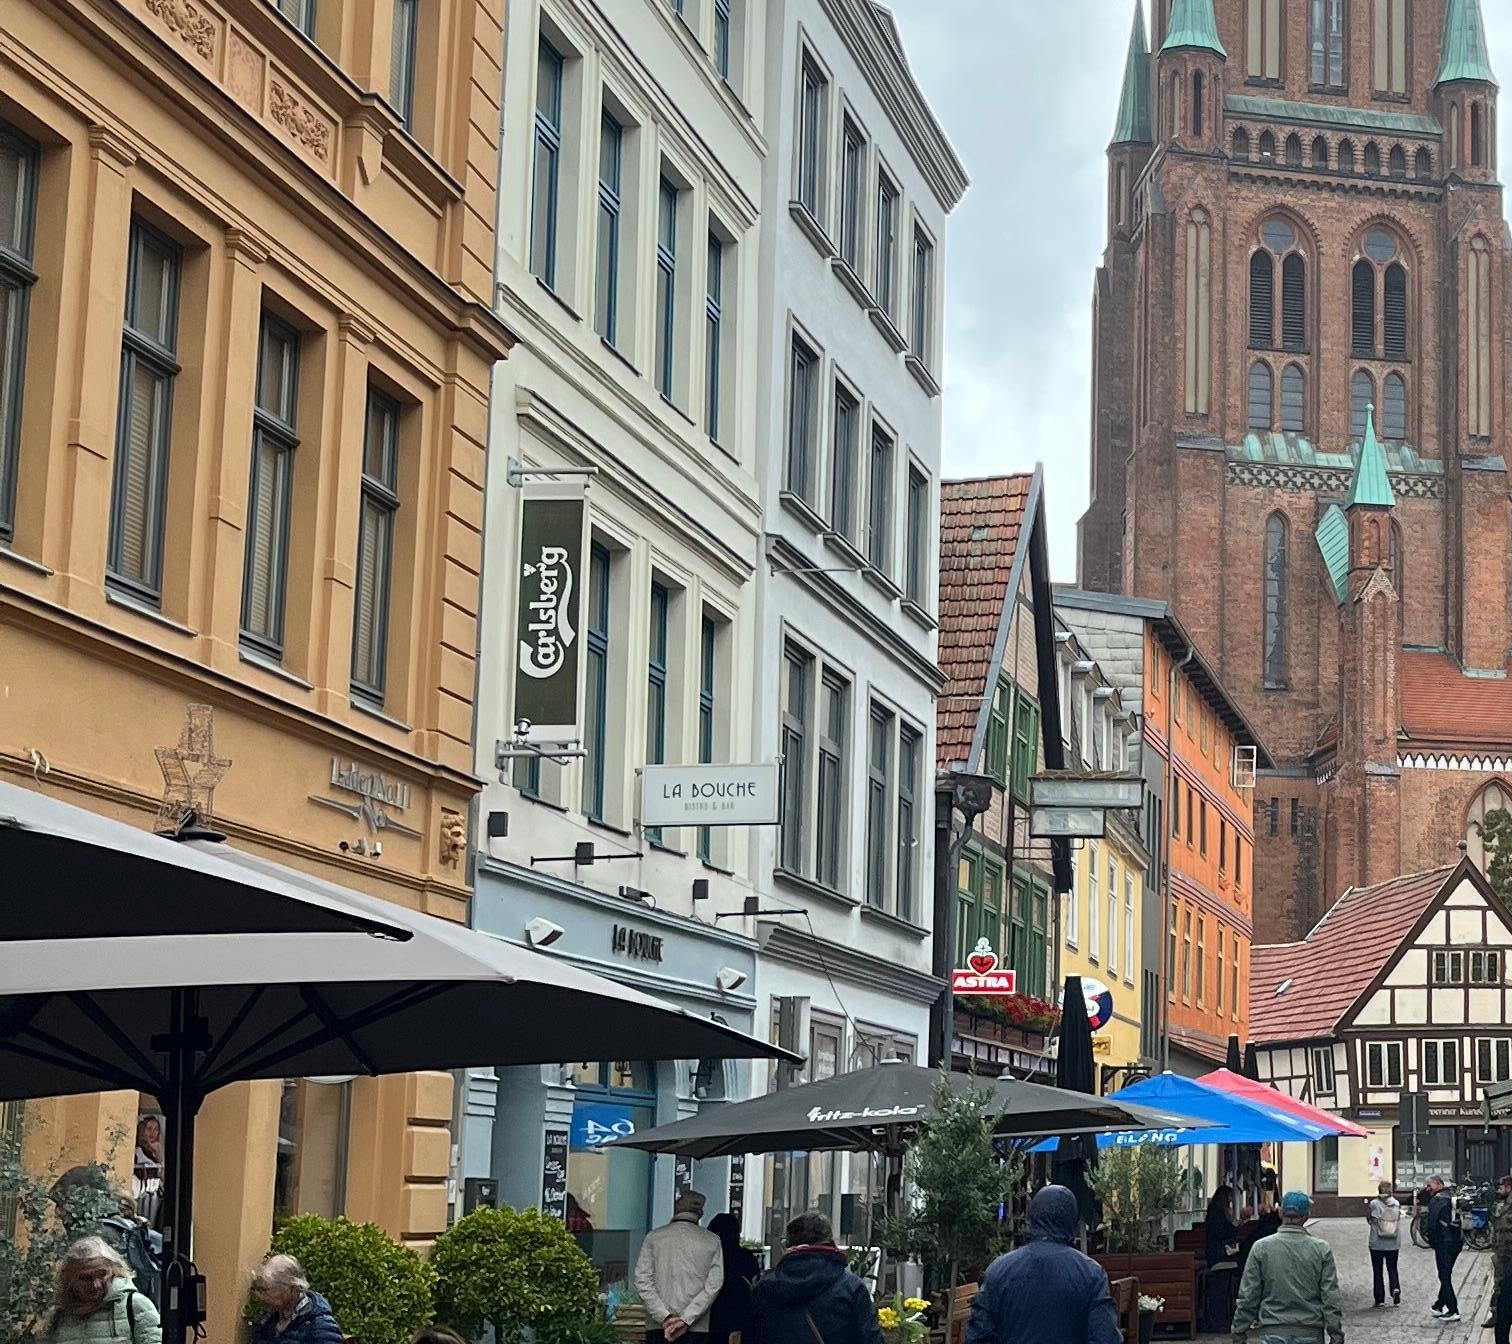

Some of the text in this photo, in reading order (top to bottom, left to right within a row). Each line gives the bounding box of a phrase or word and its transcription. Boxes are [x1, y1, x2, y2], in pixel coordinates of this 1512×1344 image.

[519, 545, 573, 679] Carlsberg
[663, 782, 756, 798] LA BOUCHE
[953, 976, 1010, 988] ASTRA
[806, 1105, 918, 1122] fritz-kola
